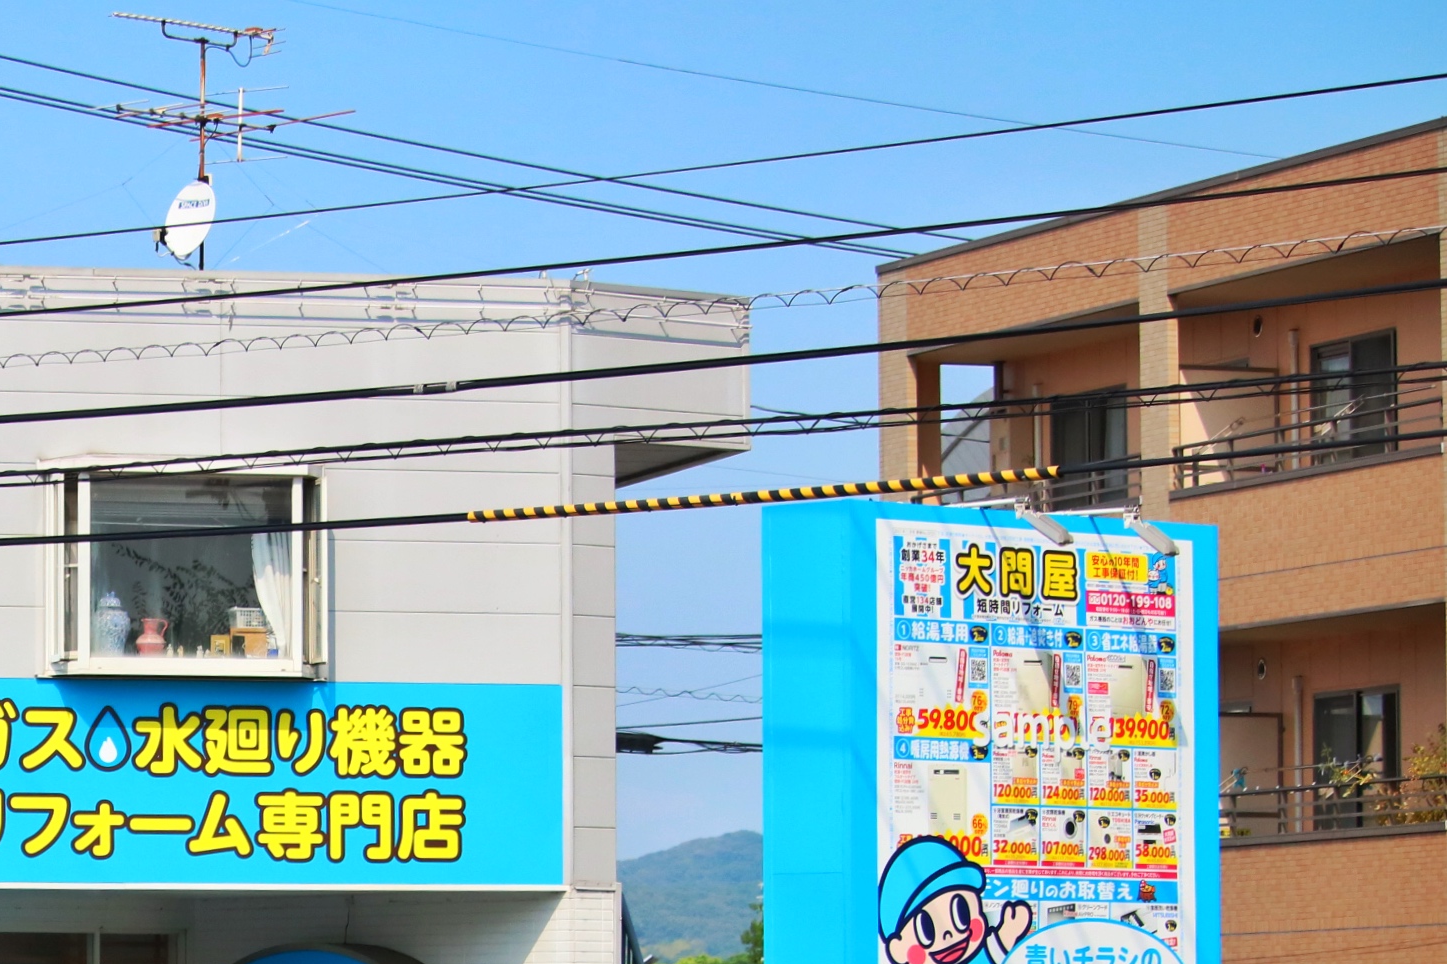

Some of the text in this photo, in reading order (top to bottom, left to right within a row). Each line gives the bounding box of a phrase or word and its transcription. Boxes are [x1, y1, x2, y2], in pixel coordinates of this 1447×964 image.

[901, 549, 944, 563] 創業34年
[1092, 555, 1139, 568] 安心の10年間
[956, 543, 1077, 601] 大問屋
[977, 598, 1064, 616] 短時間リフォーム
[1101, 593, 1172, 609] 0120-199-108
[911, 621, 968, 642] 給湯専用
[133, 703, 468, 778] 水廻り機器
[973, 706, 1111, 764] sample
